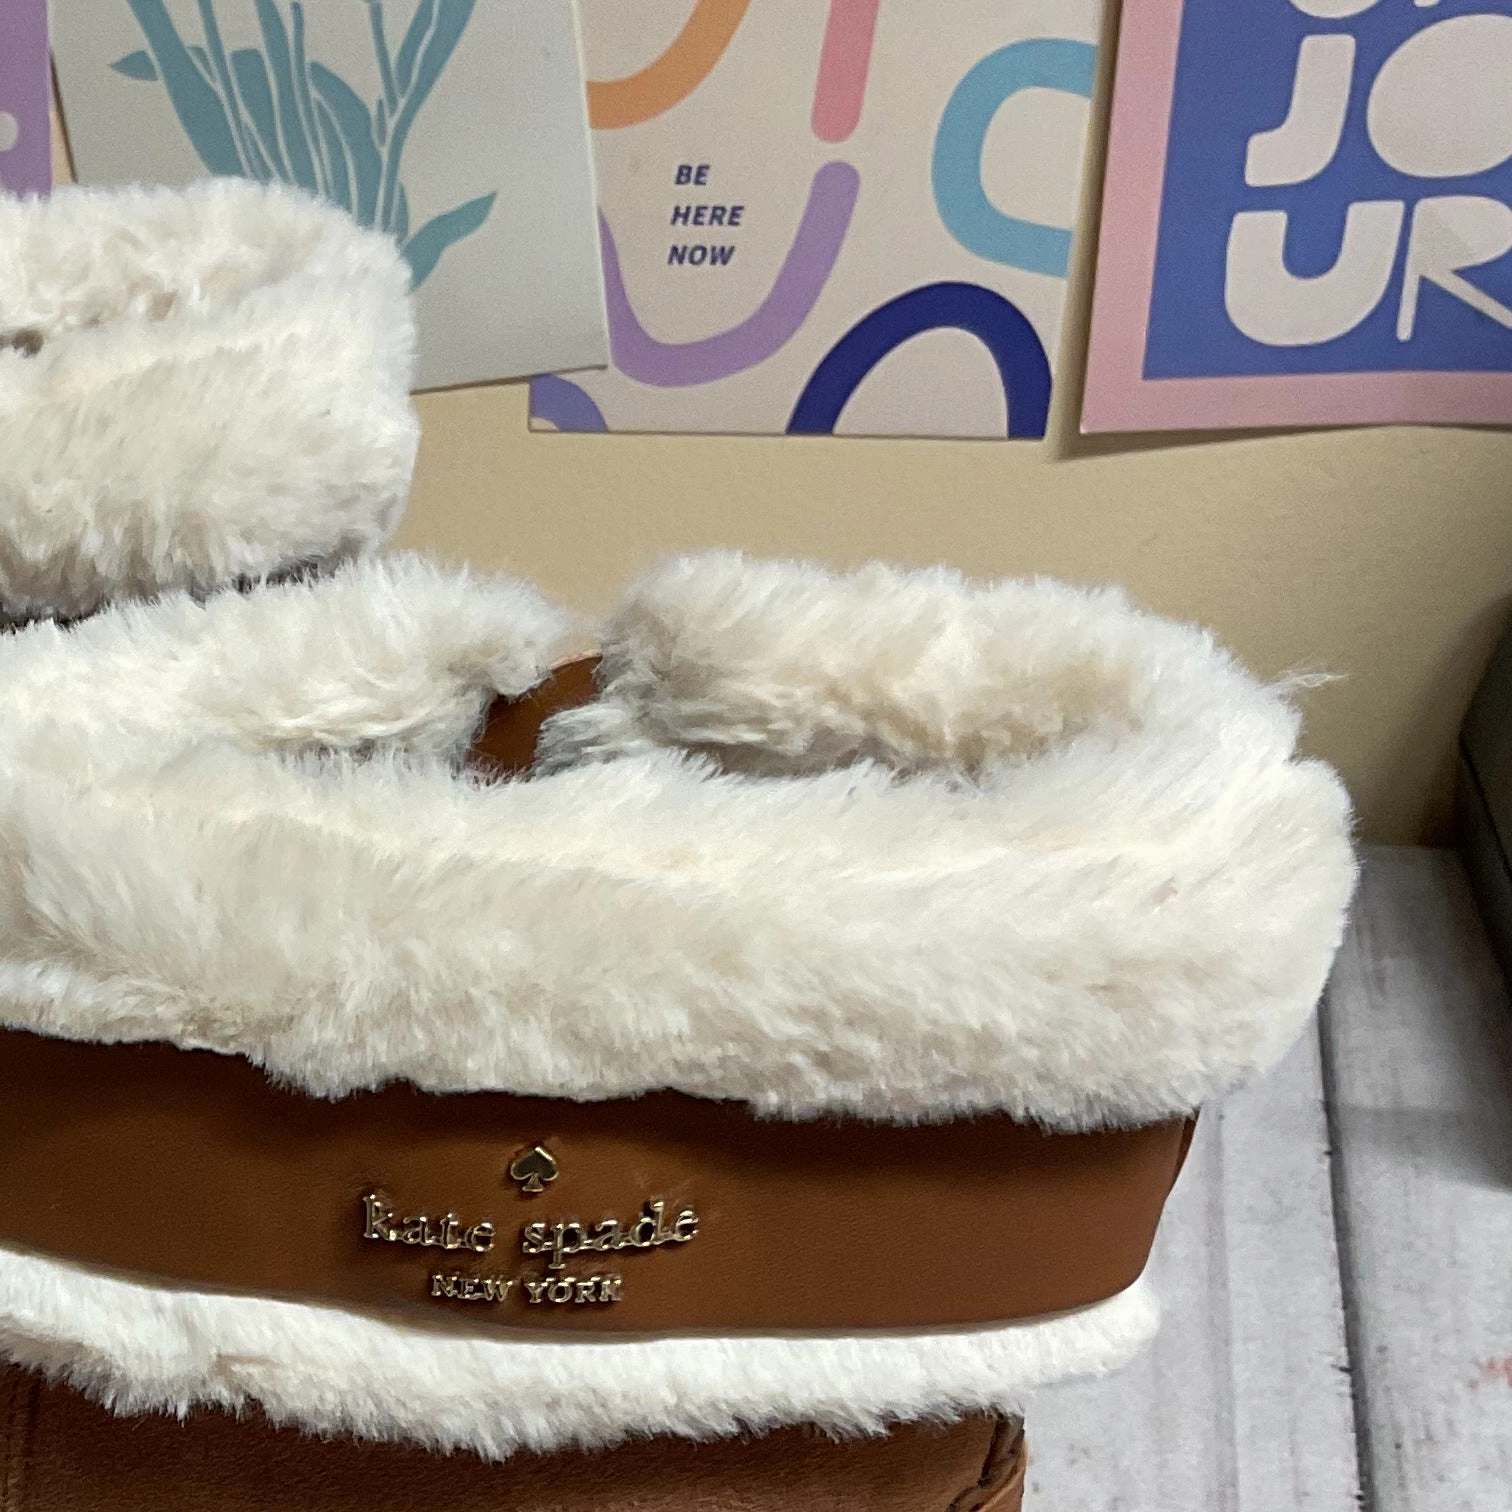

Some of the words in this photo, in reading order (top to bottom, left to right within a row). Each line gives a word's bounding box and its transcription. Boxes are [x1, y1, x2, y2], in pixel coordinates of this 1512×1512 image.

[674, 164, 710, 186] BE
[670, 205, 745, 226] HERE
[667, 245, 736, 266] NOW
[362, 1193, 497, 1253] kate
[521, 1199, 701, 1270] spade
[430, 1273, 514, 1302] NEW
[523, 1275, 625, 1304] YORK
